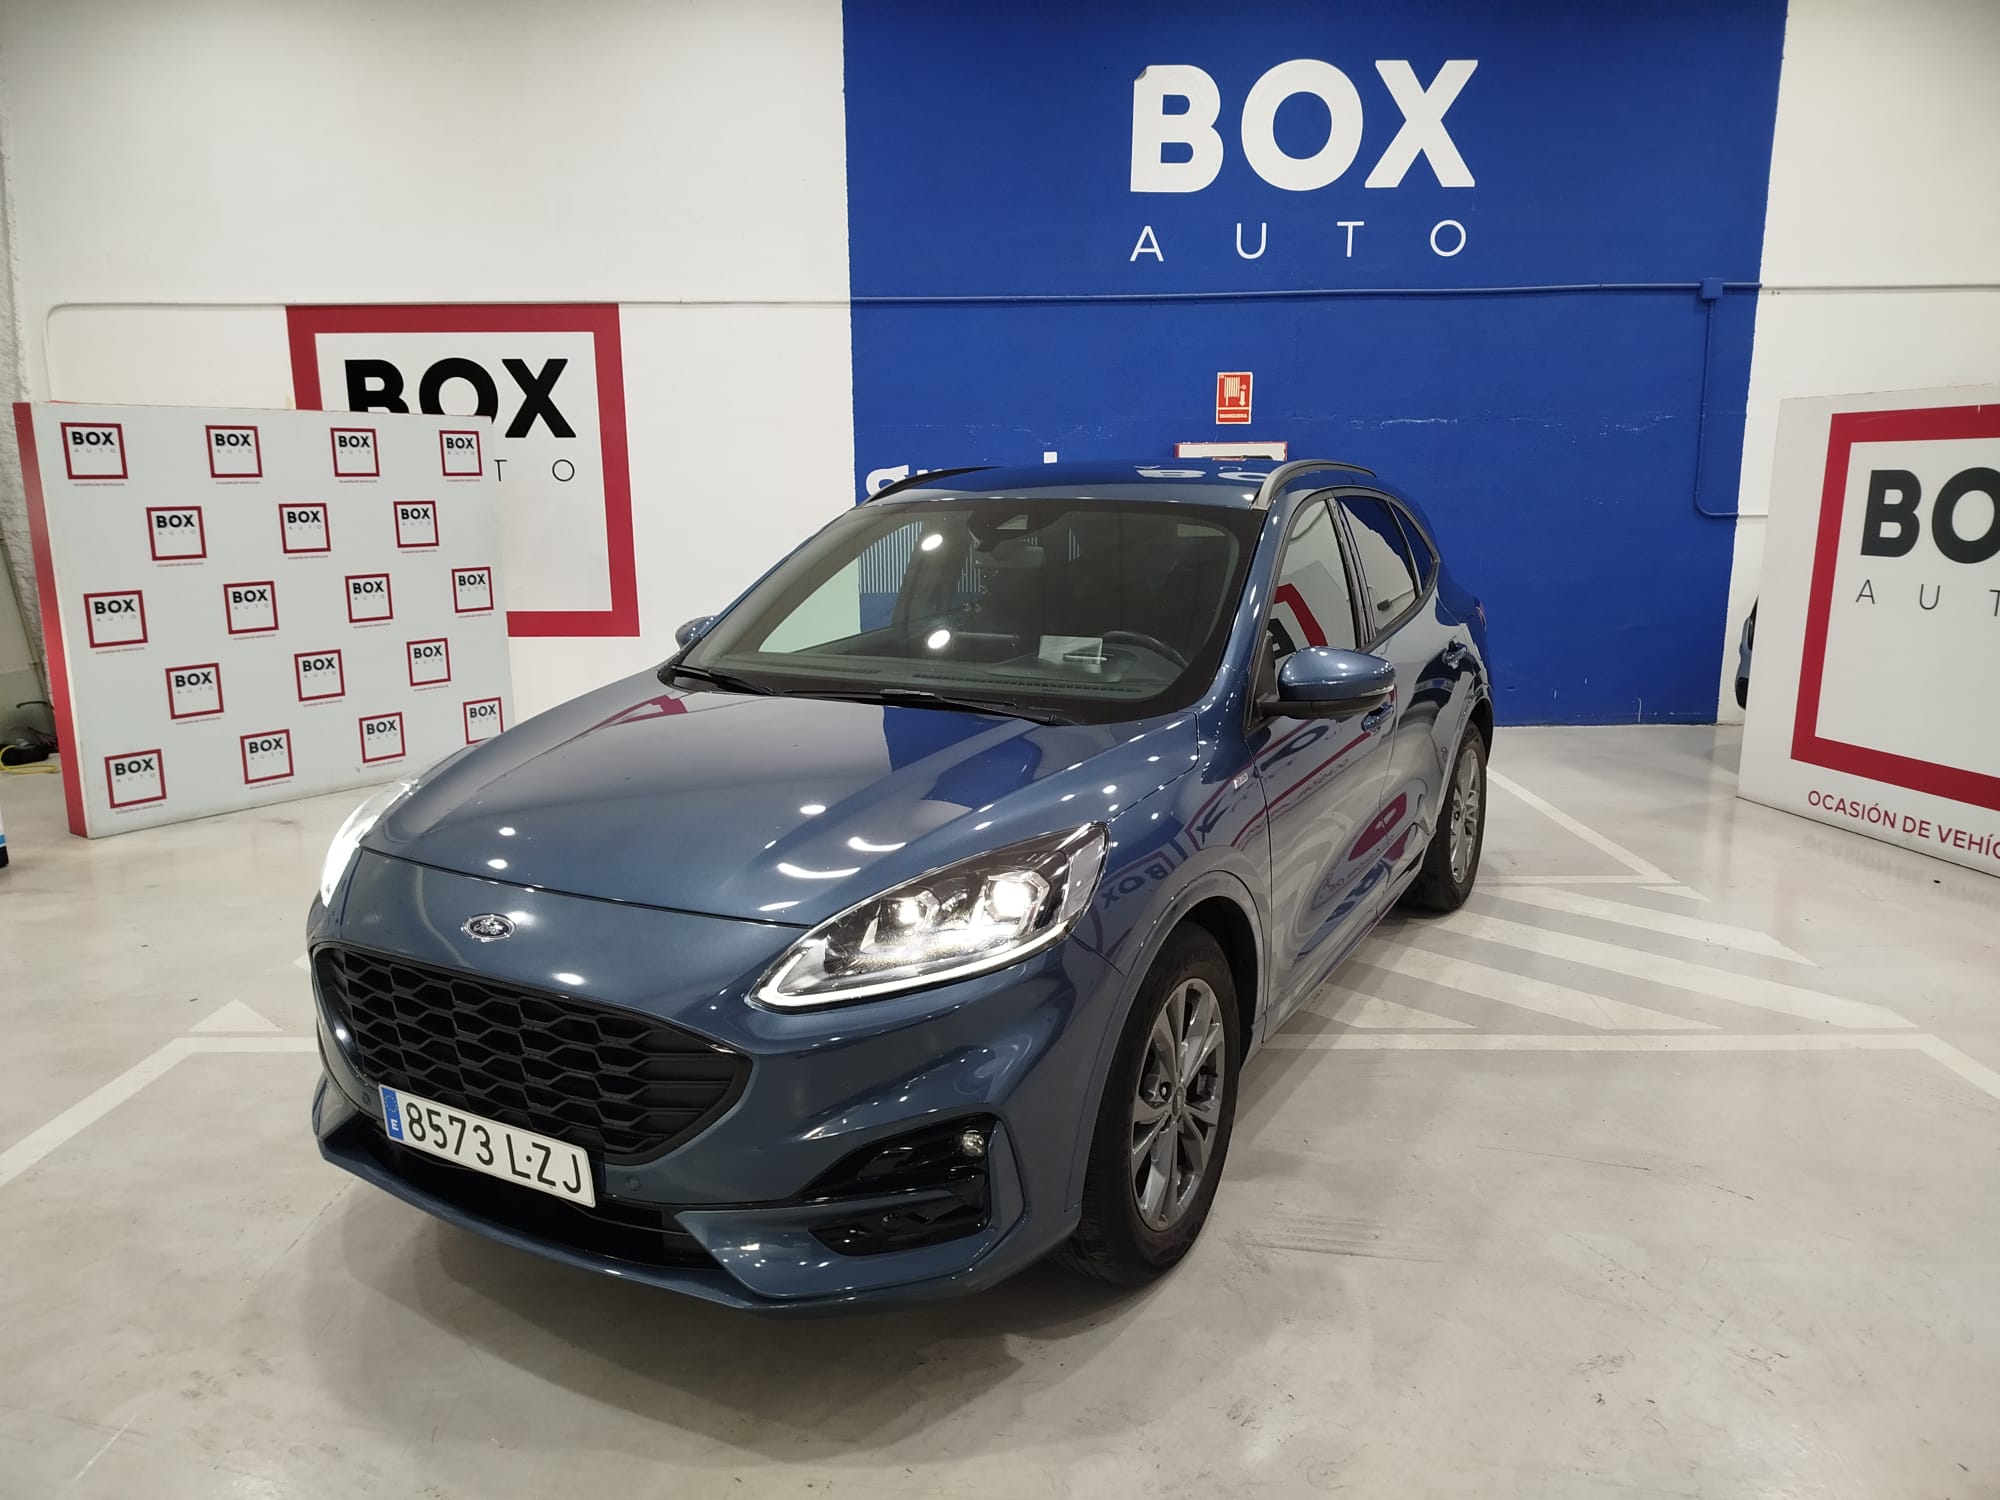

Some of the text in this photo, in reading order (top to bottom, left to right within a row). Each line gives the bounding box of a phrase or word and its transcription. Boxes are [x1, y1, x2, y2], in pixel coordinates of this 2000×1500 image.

[1130, 59, 1479, 193] BOX
[1130, 220, 1467, 262] AUTO
[345, 357, 577, 438] BOX
[71, 431, 115, 446] BOX
[214, 433, 252, 447] BOX
[338, 435, 371, 448] BOX
[445, 437, 474, 450] BOX
[155, 514, 195, 529] BOX
[286, 510, 321, 524] BOX
[400, 507, 431, 520] BOX
[352, 580, 385, 595] BOX
[458, 573, 486, 587] BOX
[232, 588, 268, 604] BOX
[93, 598, 136, 615] BOX
[413, 644, 443, 659] BOX
[302, 657, 336, 673] BOX
[174, 671, 213, 688] BOX
[469, 704, 497, 719] BOX
[366, 719, 397, 735] BOX
[248, 737, 284, 754] BOX
[114, 757, 155, 777] BOX
[1808, 790, 1897, 829] OCASIÓN
[1902, 816, 1931, 839] DE
[391, 1118, 399, 1132] E
[406, 1102, 494, 1166] 8573
